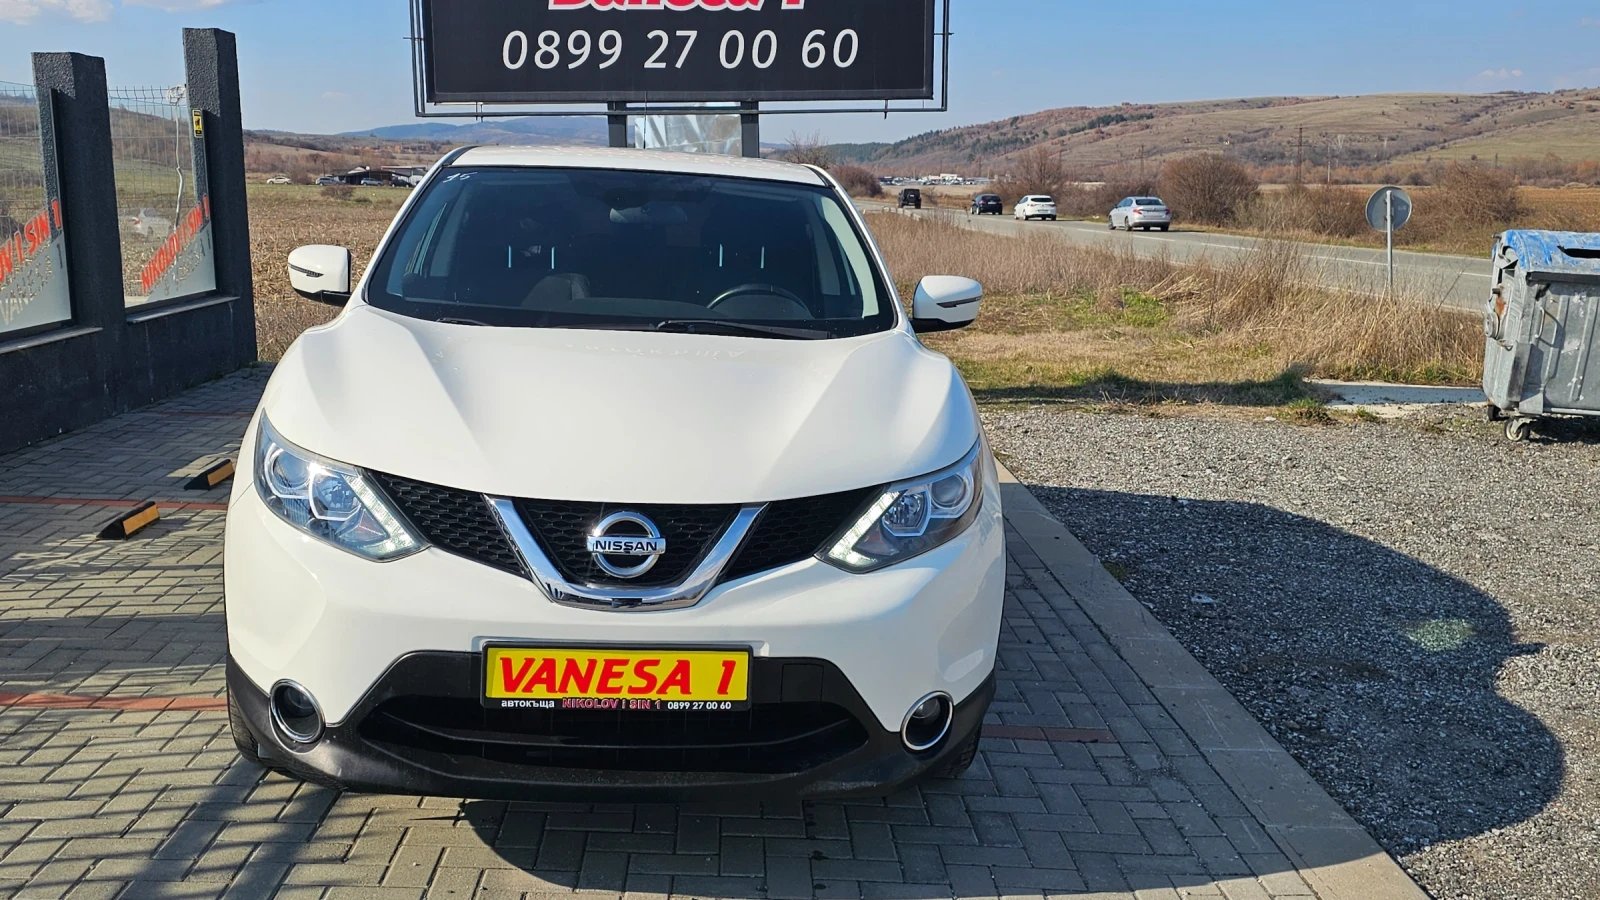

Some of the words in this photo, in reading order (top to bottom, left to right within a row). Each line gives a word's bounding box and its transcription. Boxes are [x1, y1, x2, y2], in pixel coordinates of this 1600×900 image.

[502, 30, 623, 70] 0899
[643, 30, 698, 69] 27
[719, 30, 778, 69] 00
[801, 29, 859, 69] 60
[25, 209, 50, 255] SIN
[141, 229, 181, 294] NIKOLOV
[595, 540, 657, 552] NISSAN
[500, 658, 692, 694] VANESA
[717, 660, 736, 694] 1
[501, 699, 555, 709] автокъща
[562, 697, 619, 708] NIKOLOV
[629, 699, 651, 709] SIN
[654, 700, 661, 709] 1
[667, 701, 690, 710] 0899
[692, 701, 704, 710] 27
[706, 701, 718, 710] 00
[719, 701, 732, 710] 60
